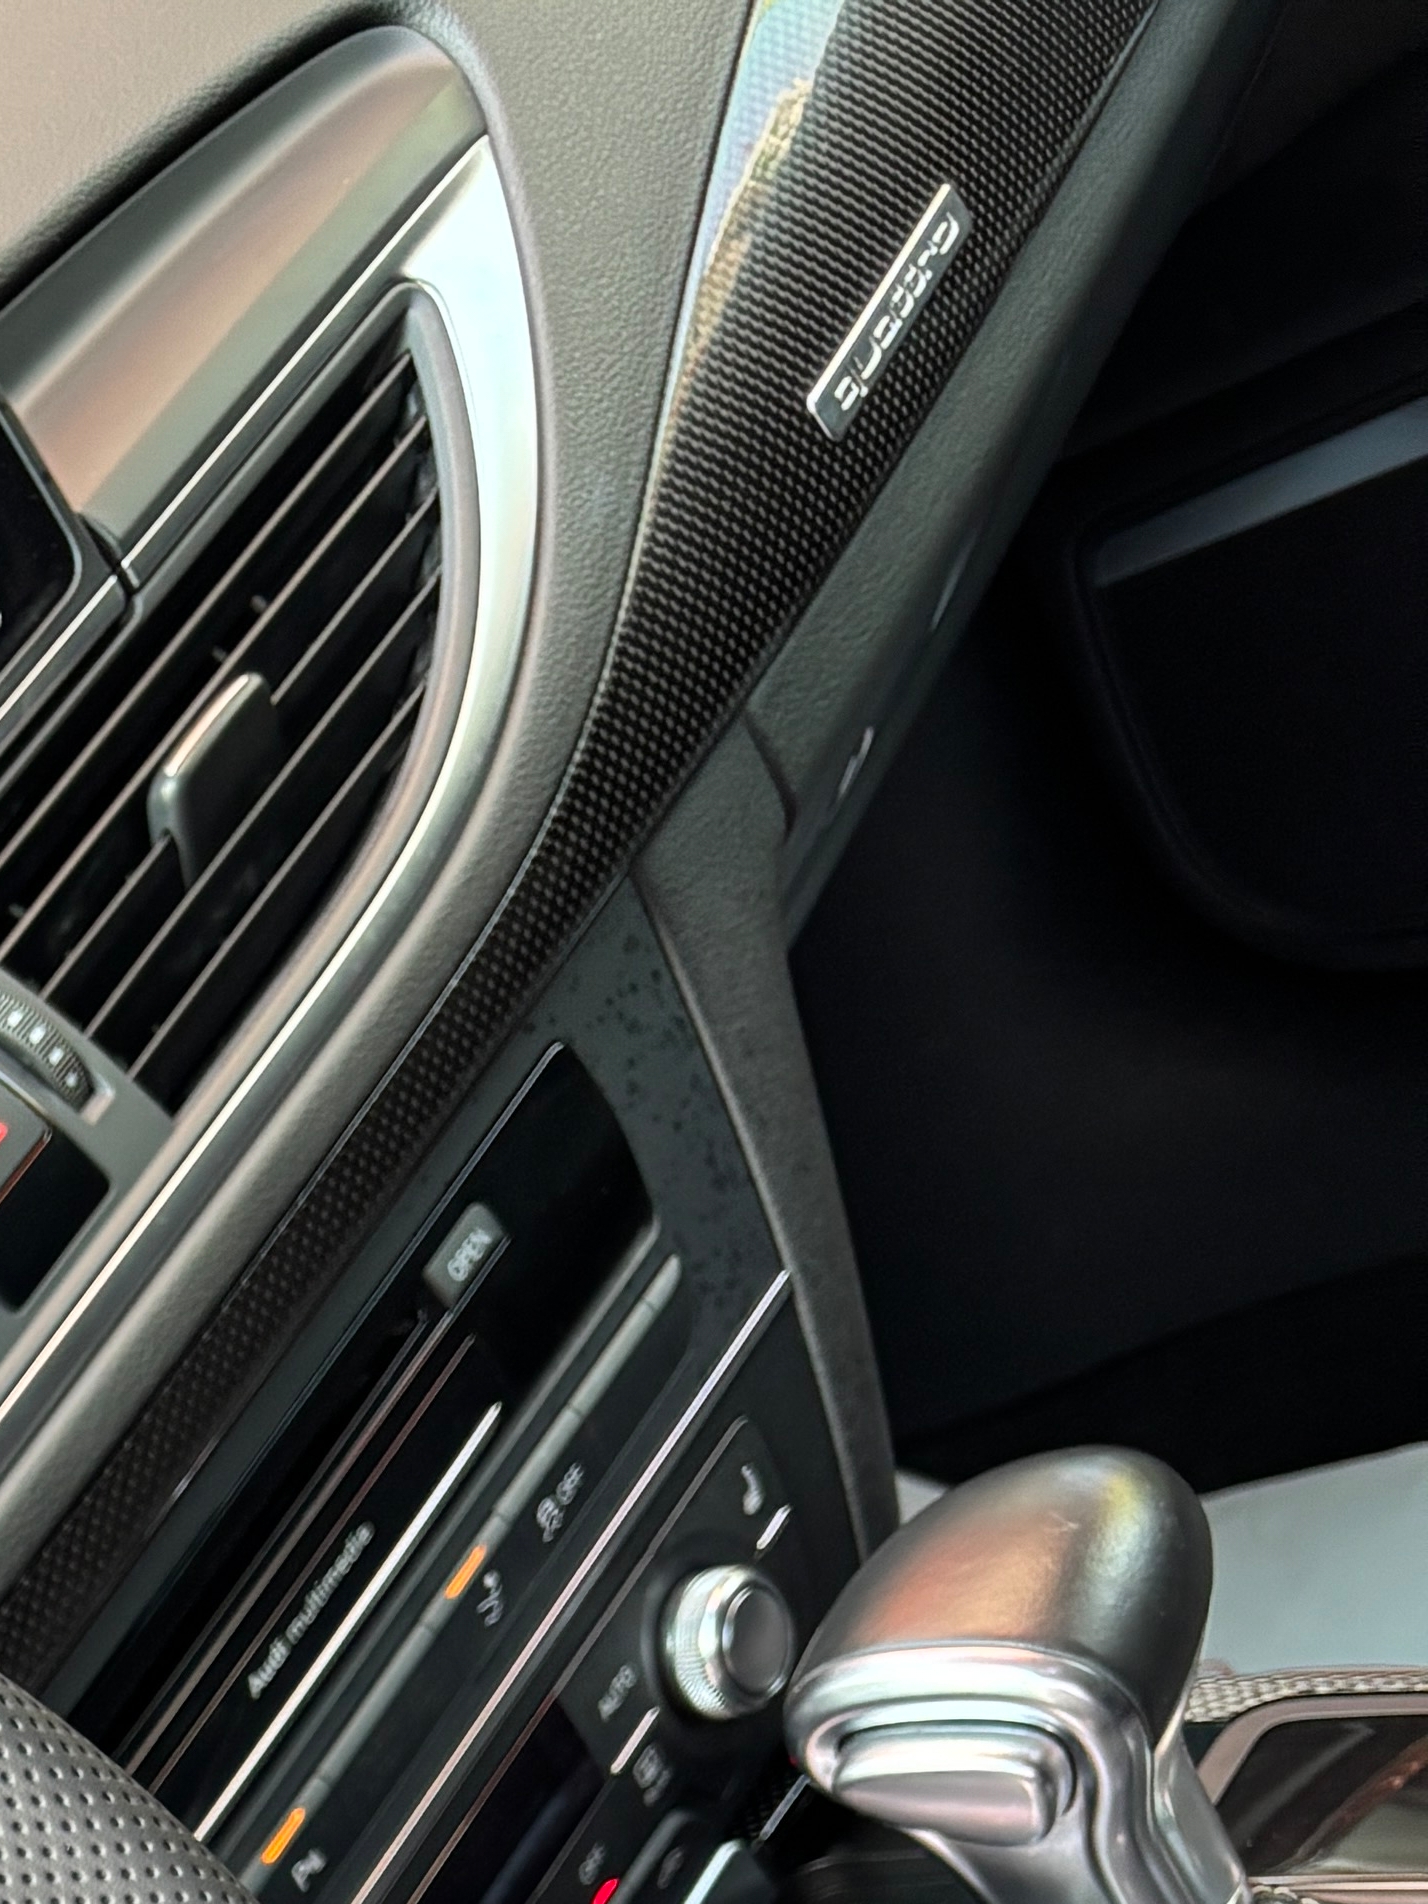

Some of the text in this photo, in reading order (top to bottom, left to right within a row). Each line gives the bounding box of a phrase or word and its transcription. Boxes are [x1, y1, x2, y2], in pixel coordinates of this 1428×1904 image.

[834, 212, 959, 410] quattro
[245, 1519, 376, 1697] Audi multimedia
